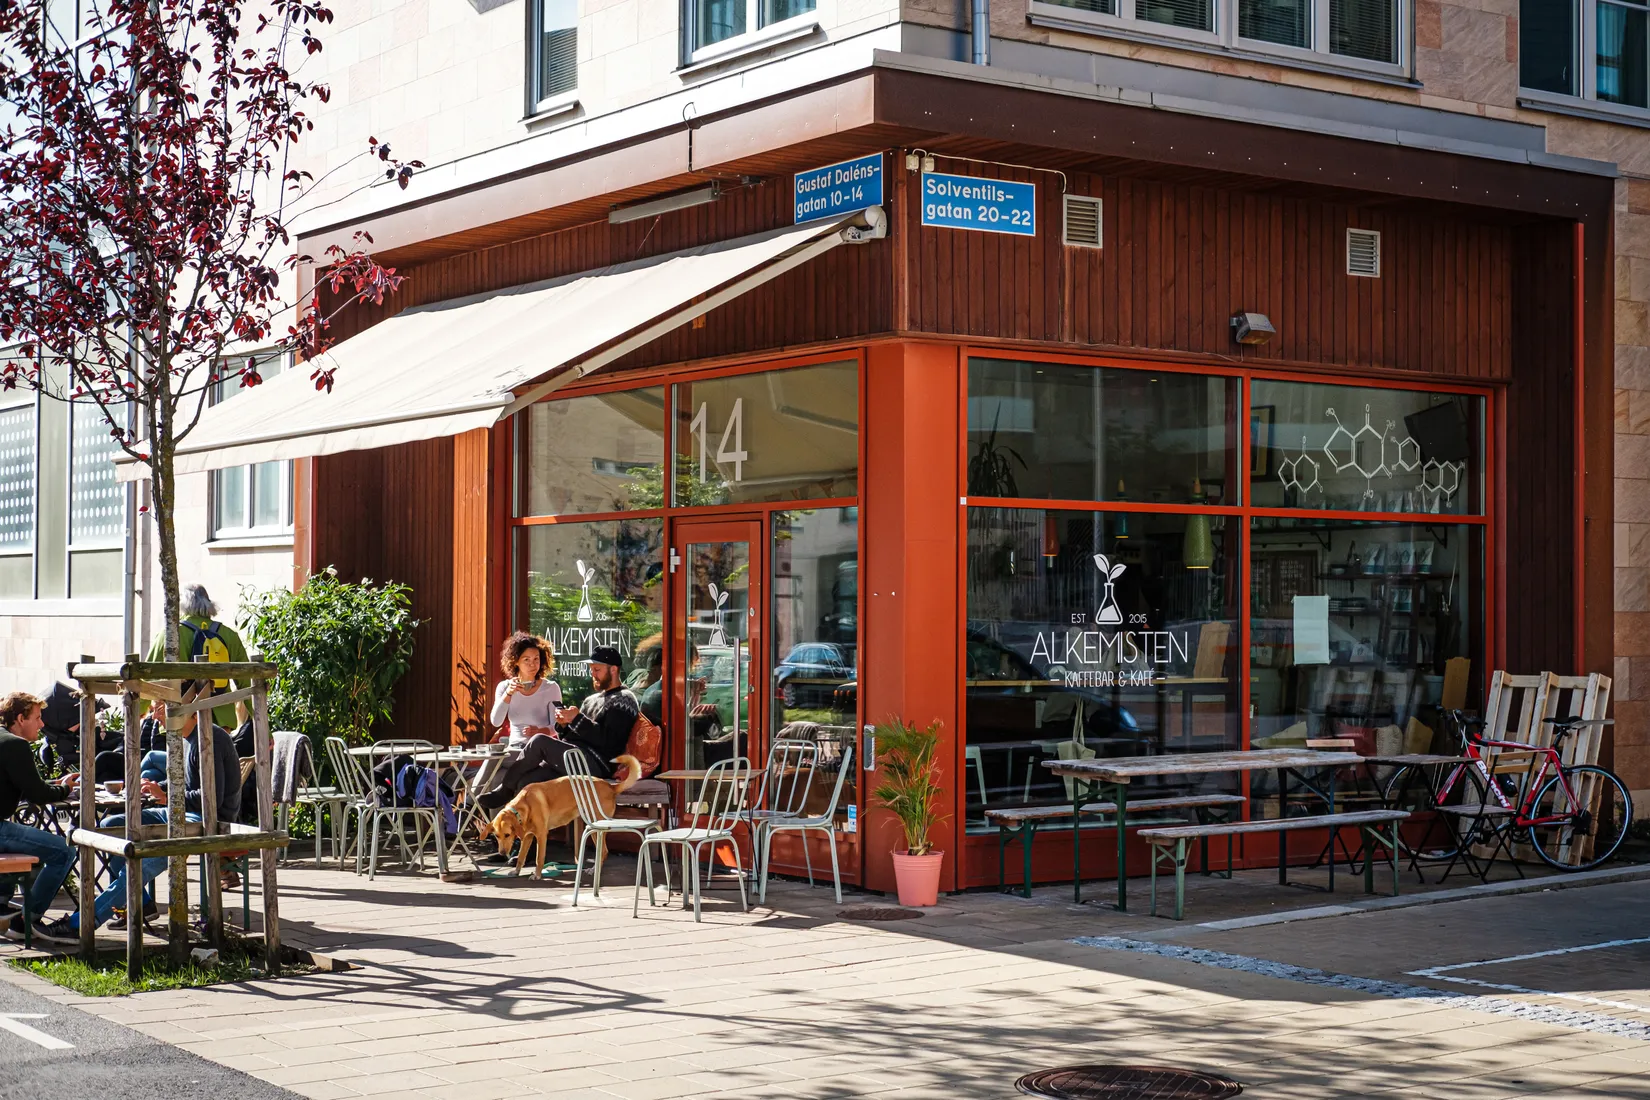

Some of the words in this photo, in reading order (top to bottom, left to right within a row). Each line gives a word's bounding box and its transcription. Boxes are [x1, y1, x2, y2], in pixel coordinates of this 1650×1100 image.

[797, 171, 832, 194] Gustaf
[835, 164, 880, 185] Daléns-
[926, 178, 1014, 202] Solventils-
[797, 197, 827, 219] gatan
[830, 185, 863, 207] 10-14
[926, 202, 972, 220] gatan
[977, 205, 1031, 226] 20-22
[689, 397, 748, 484] 14
[563, 611, 573, 621] EST
[1071, 613, 1086, 624] EST
[1128, 613, 1148, 624] 2015
[1029, 631, 1188, 665] ALKEMISTEN
[559, 661, 588, 678] KAFFEBAR
[1064, 670, 1115, 688] KAFFEBAR
[1118, 671, 1127, 687] &
[1130, 668, 1155, 687] KAFÉ
